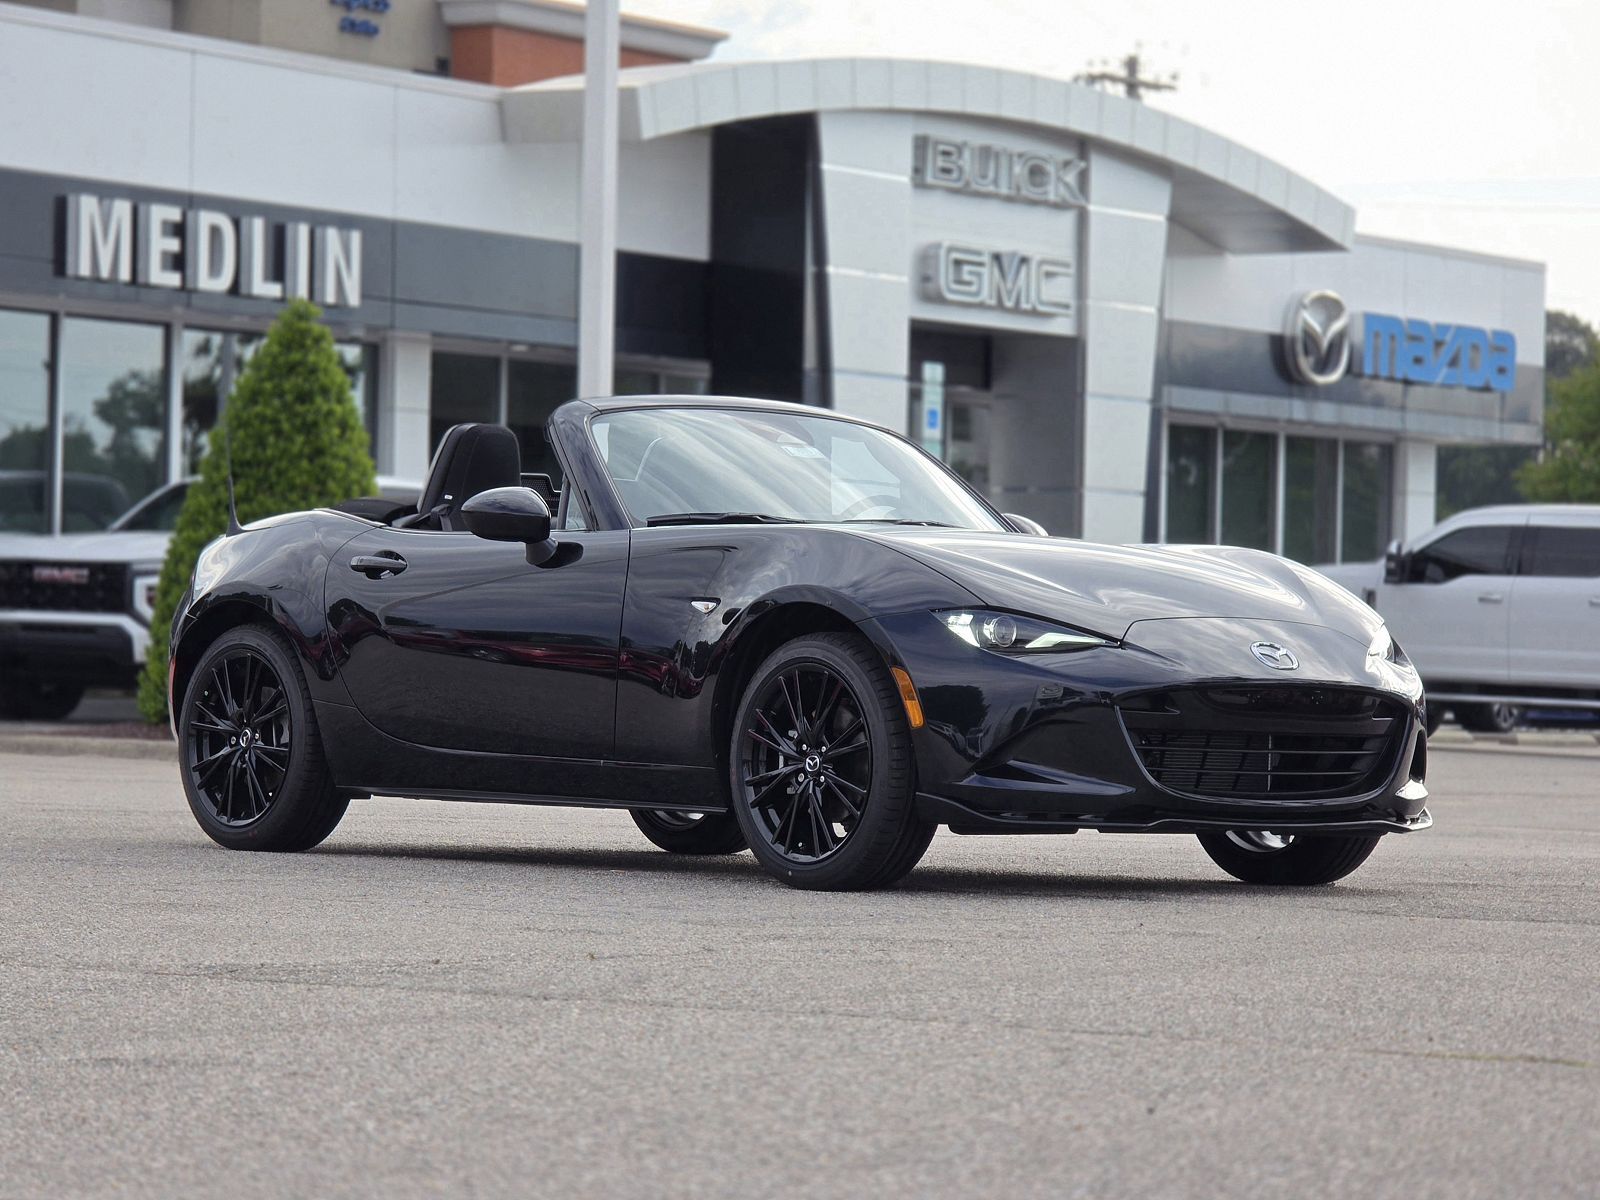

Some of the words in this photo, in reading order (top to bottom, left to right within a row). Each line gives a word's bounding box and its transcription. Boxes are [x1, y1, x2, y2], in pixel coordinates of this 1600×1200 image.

[925, 137, 1088, 207] BUICK
[70, 192, 363, 308] MEDLIN
[938, 240, 1074, 316] GMC
[1362, 312, 1517, 393] mazda
